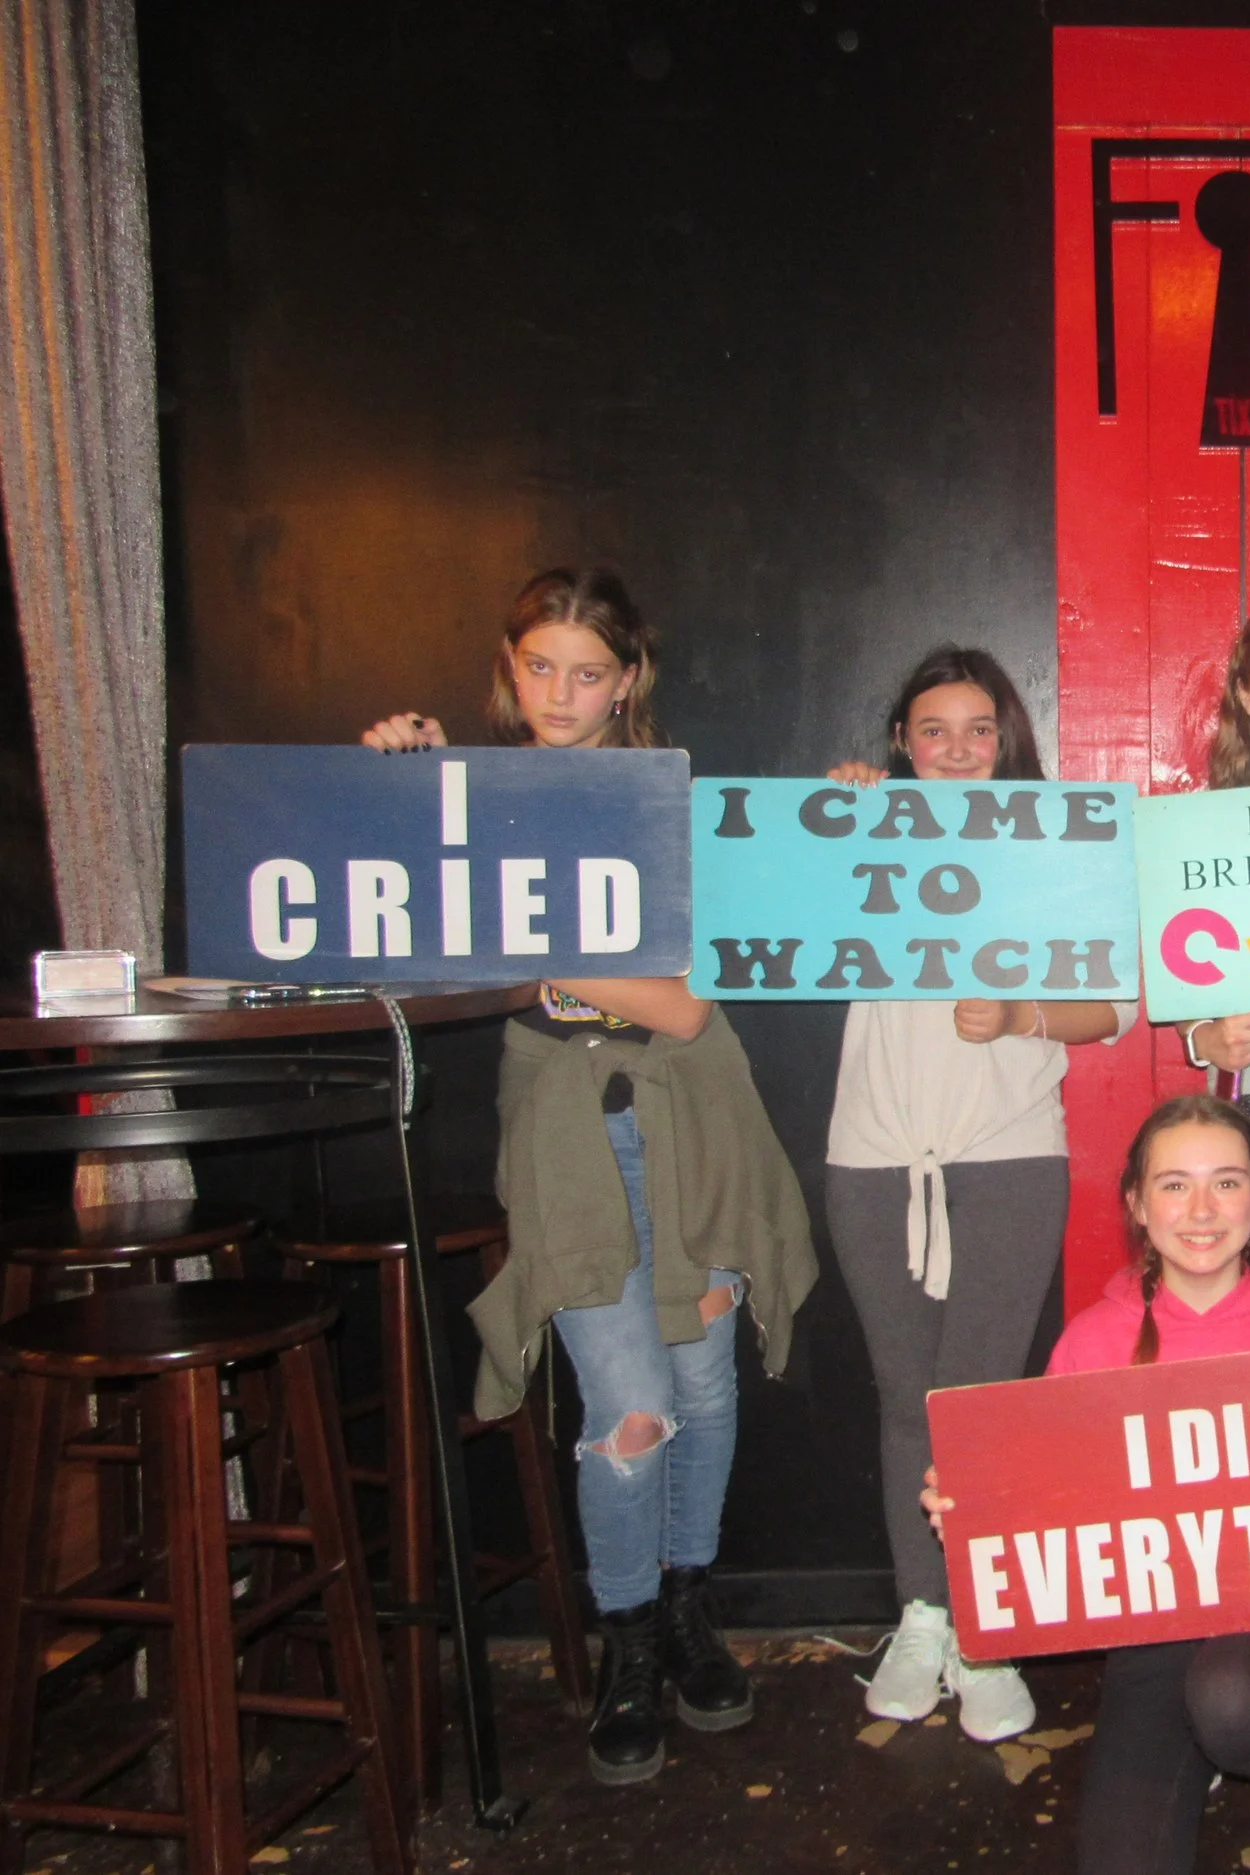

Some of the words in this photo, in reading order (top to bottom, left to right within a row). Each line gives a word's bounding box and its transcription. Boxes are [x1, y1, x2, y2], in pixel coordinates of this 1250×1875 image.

[441, 761, 468, 845] I
[714, 787, 755, 838] I
[799, 788, 1118, 841] CAME
[249, 858, 641, 960] CRIED
[852, 863, 982, 915] TO
[709, 938, 1121, 989] WATCH
[1123, 1414, 1151, 1489] I
